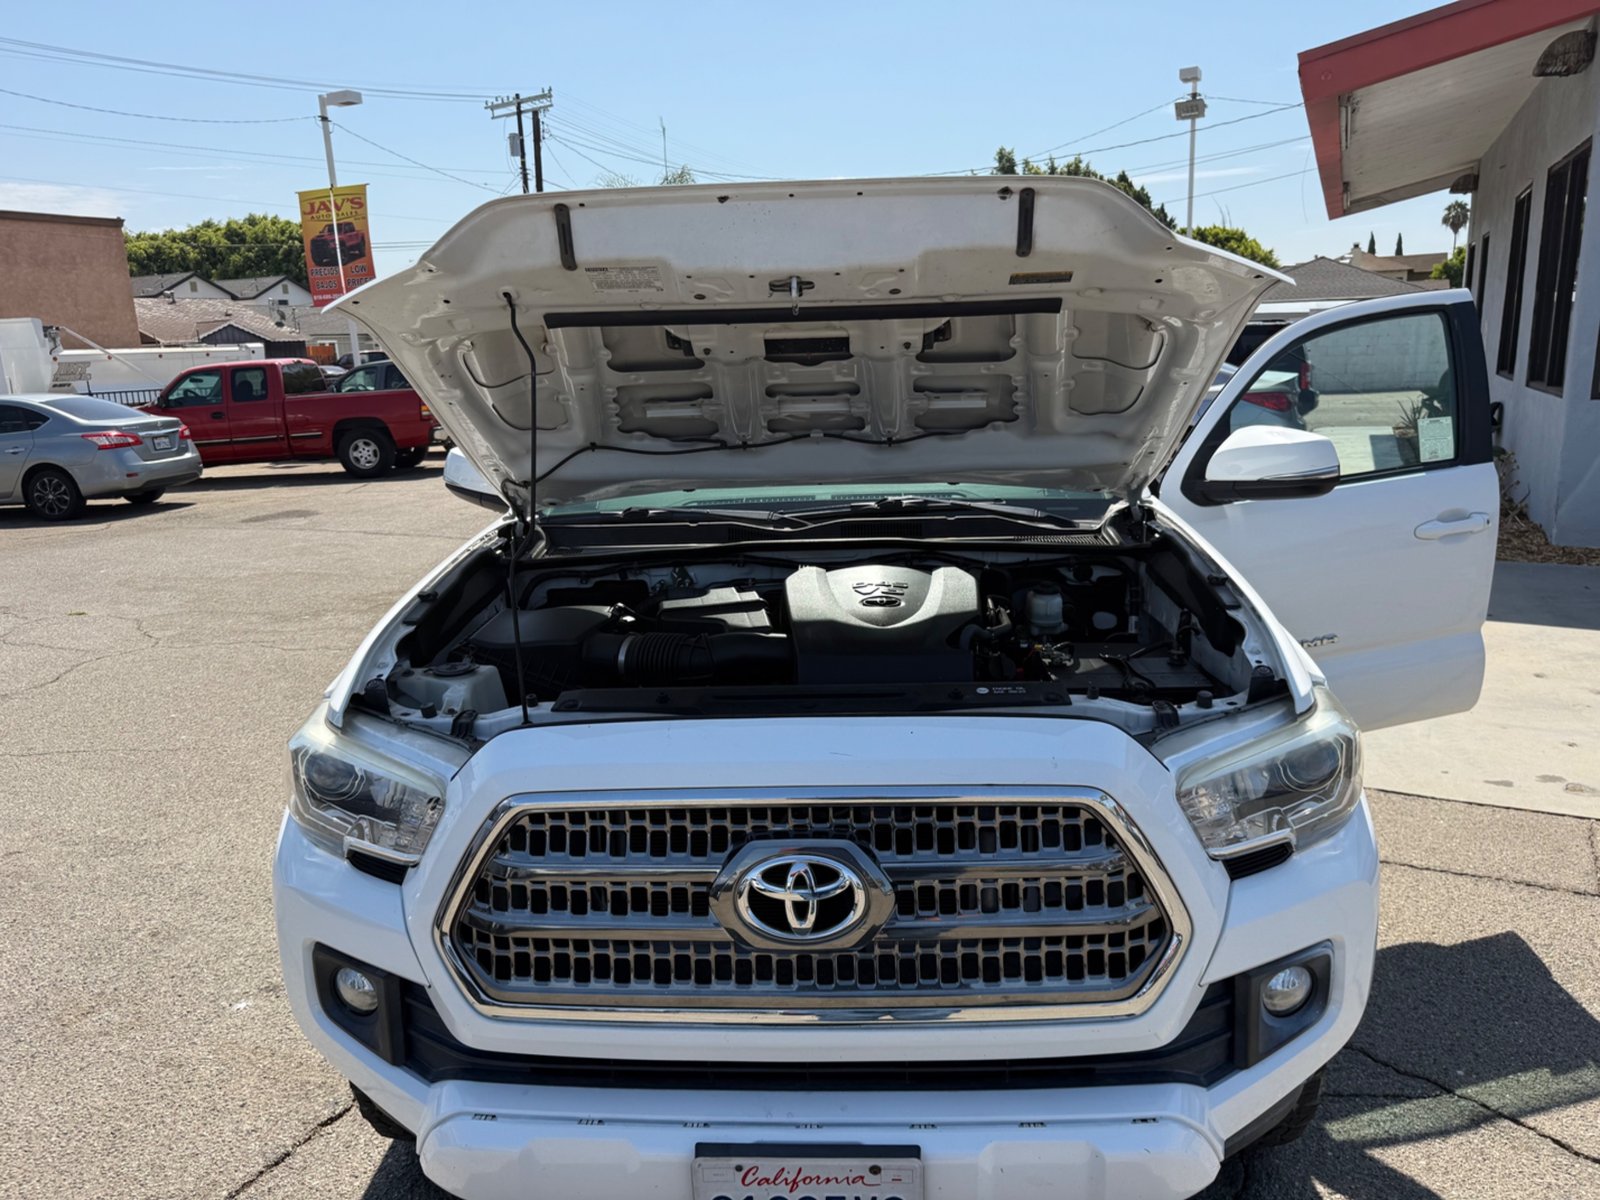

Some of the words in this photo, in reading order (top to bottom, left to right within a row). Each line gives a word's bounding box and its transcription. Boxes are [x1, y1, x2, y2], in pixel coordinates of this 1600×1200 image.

[311, 266, 339, 277] PRECIOS
[351, 264, 367, 275] LOW
[316, 280, 337, 290] BAJOS
[347, 277, 373, 288] PRICE
[741, 1165, 881, 1193] California
